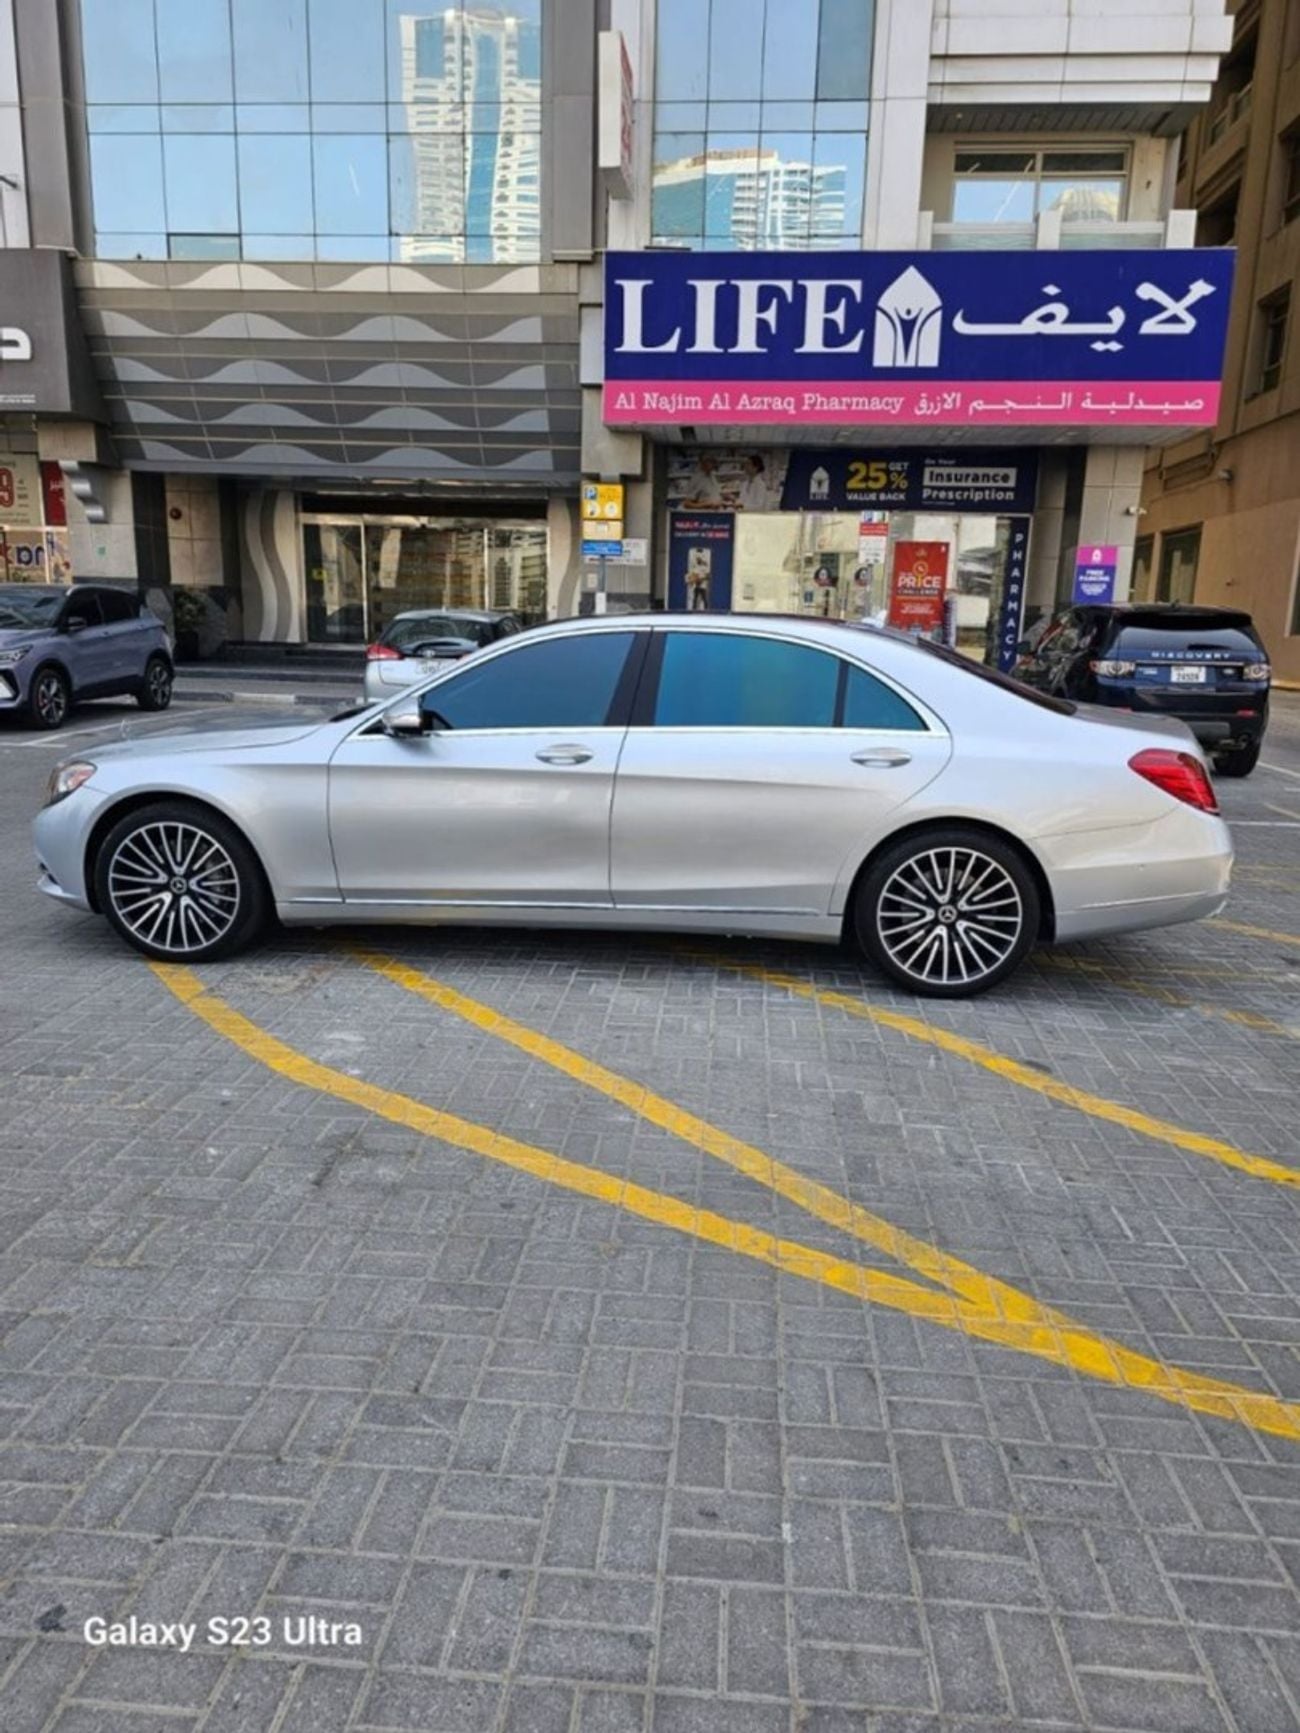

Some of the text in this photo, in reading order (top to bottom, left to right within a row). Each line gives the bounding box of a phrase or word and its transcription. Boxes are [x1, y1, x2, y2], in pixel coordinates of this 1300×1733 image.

[613, 279, 865, 353] LIFE
[952, 278, 1217, 352] لايف
[615, 393, 905, 415] Al Najim Al Azraq Pharmacy
[968, 392, 1072, 416] النجم
[1081, 392, 1204, 415] صيدلية
[888, 461, 909, 471] GET
[929, 470, 1011, 484] Insurance
[847, 492, 906, 501] VALUE BACK
[922, 488, 1015, 502] Prescription
[1003, 533, 1024, 660] PHARMACY
[1151, 651, 1231, 660] DISCOVERY
